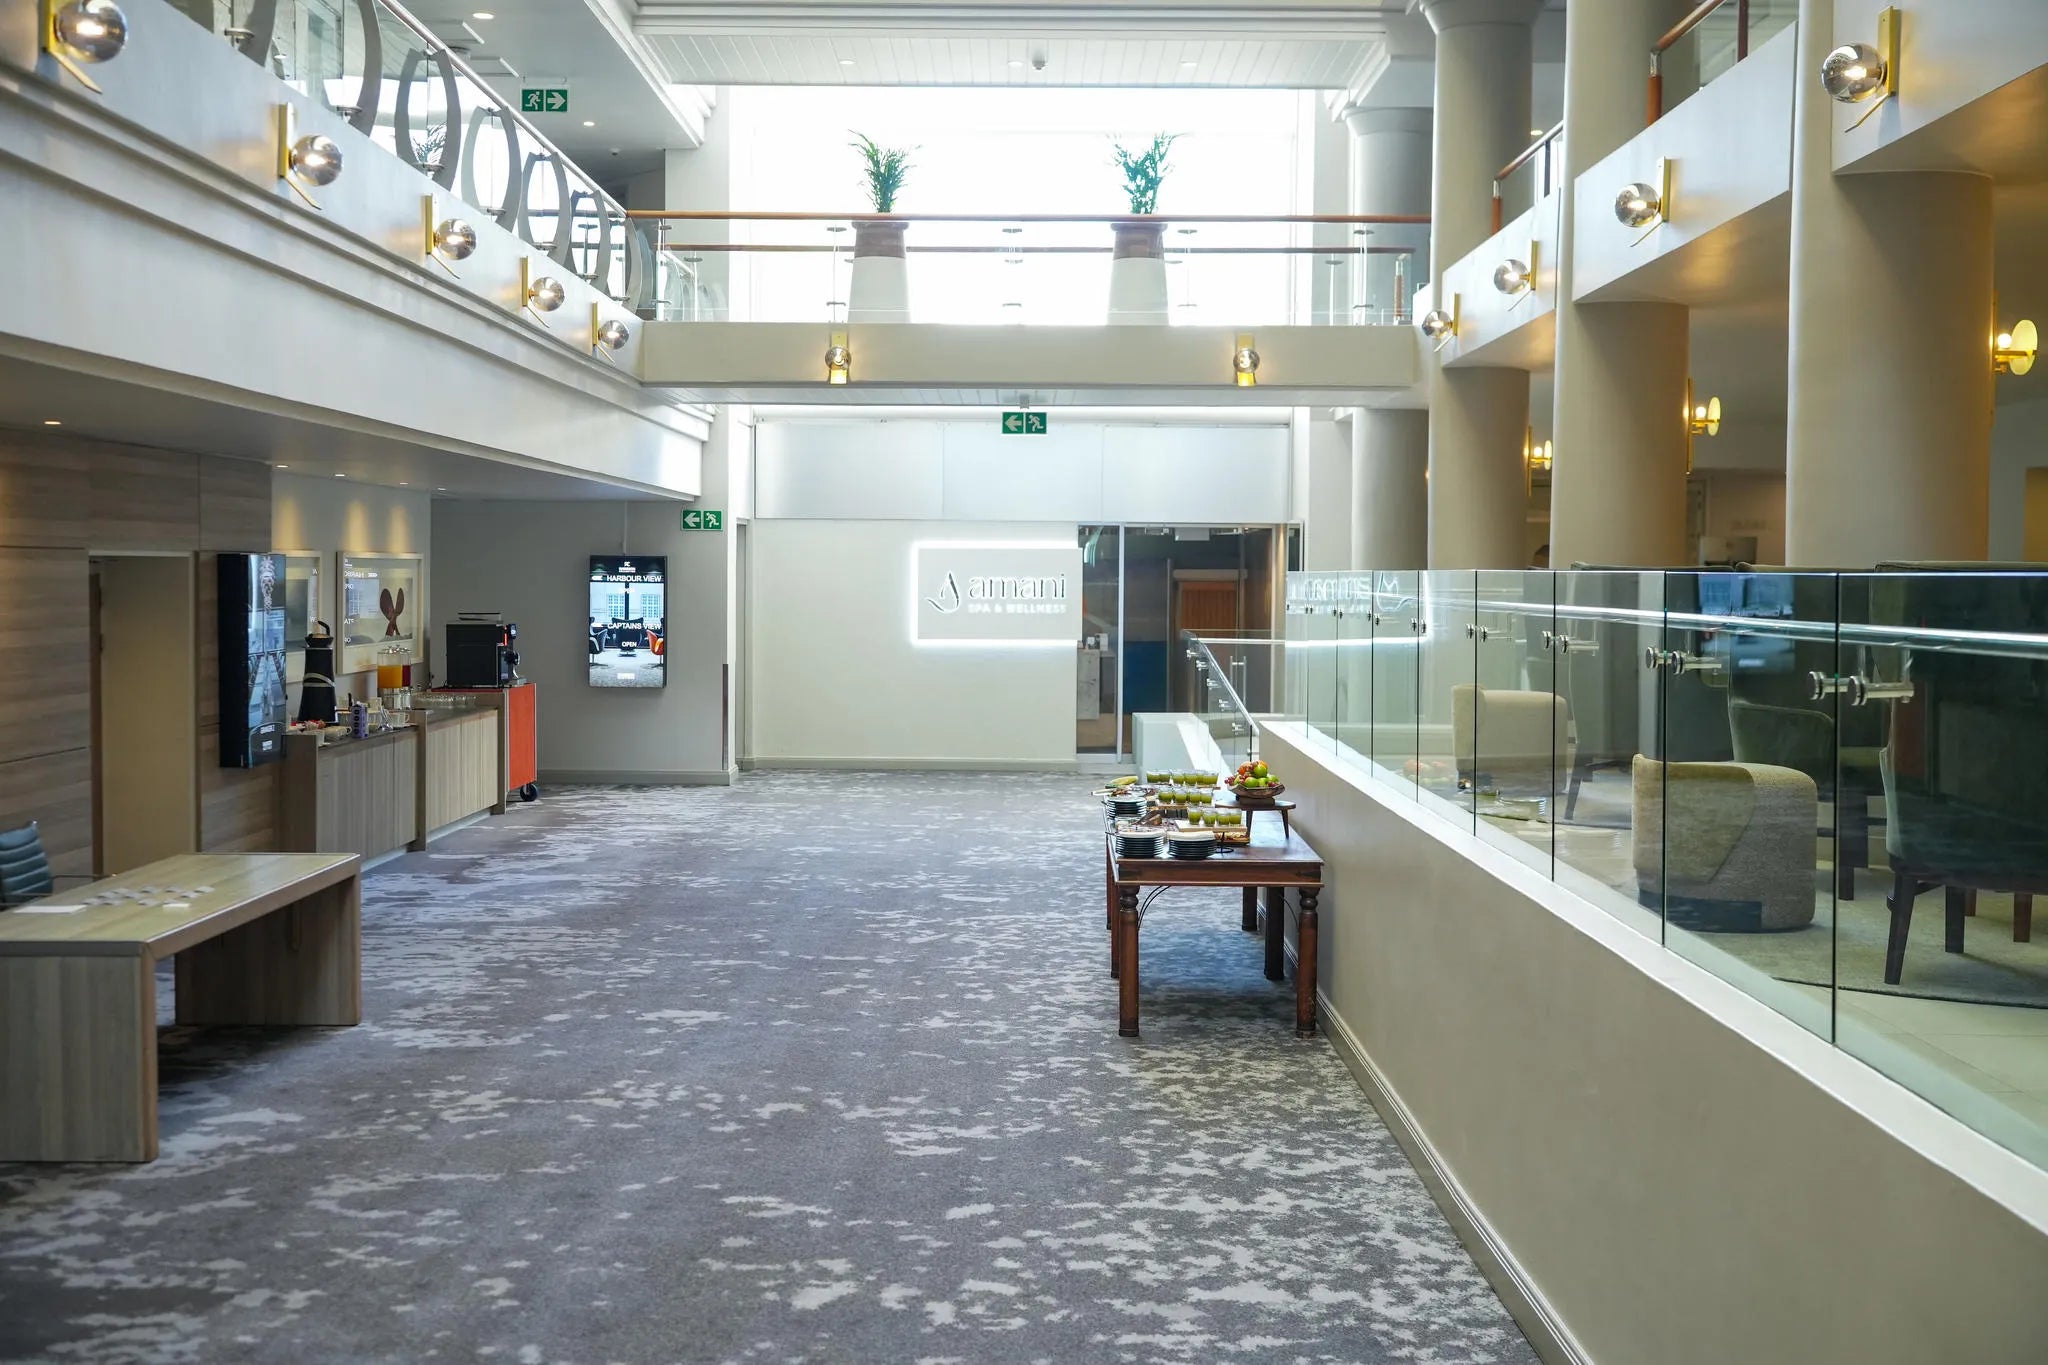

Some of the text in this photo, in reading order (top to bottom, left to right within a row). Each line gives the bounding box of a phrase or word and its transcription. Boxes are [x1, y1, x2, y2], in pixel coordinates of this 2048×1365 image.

[968, 573, 1067, 600] amani
[968, 604, 990, 614] SPA
[1006, 604, 1067, 614] WELLNESS
